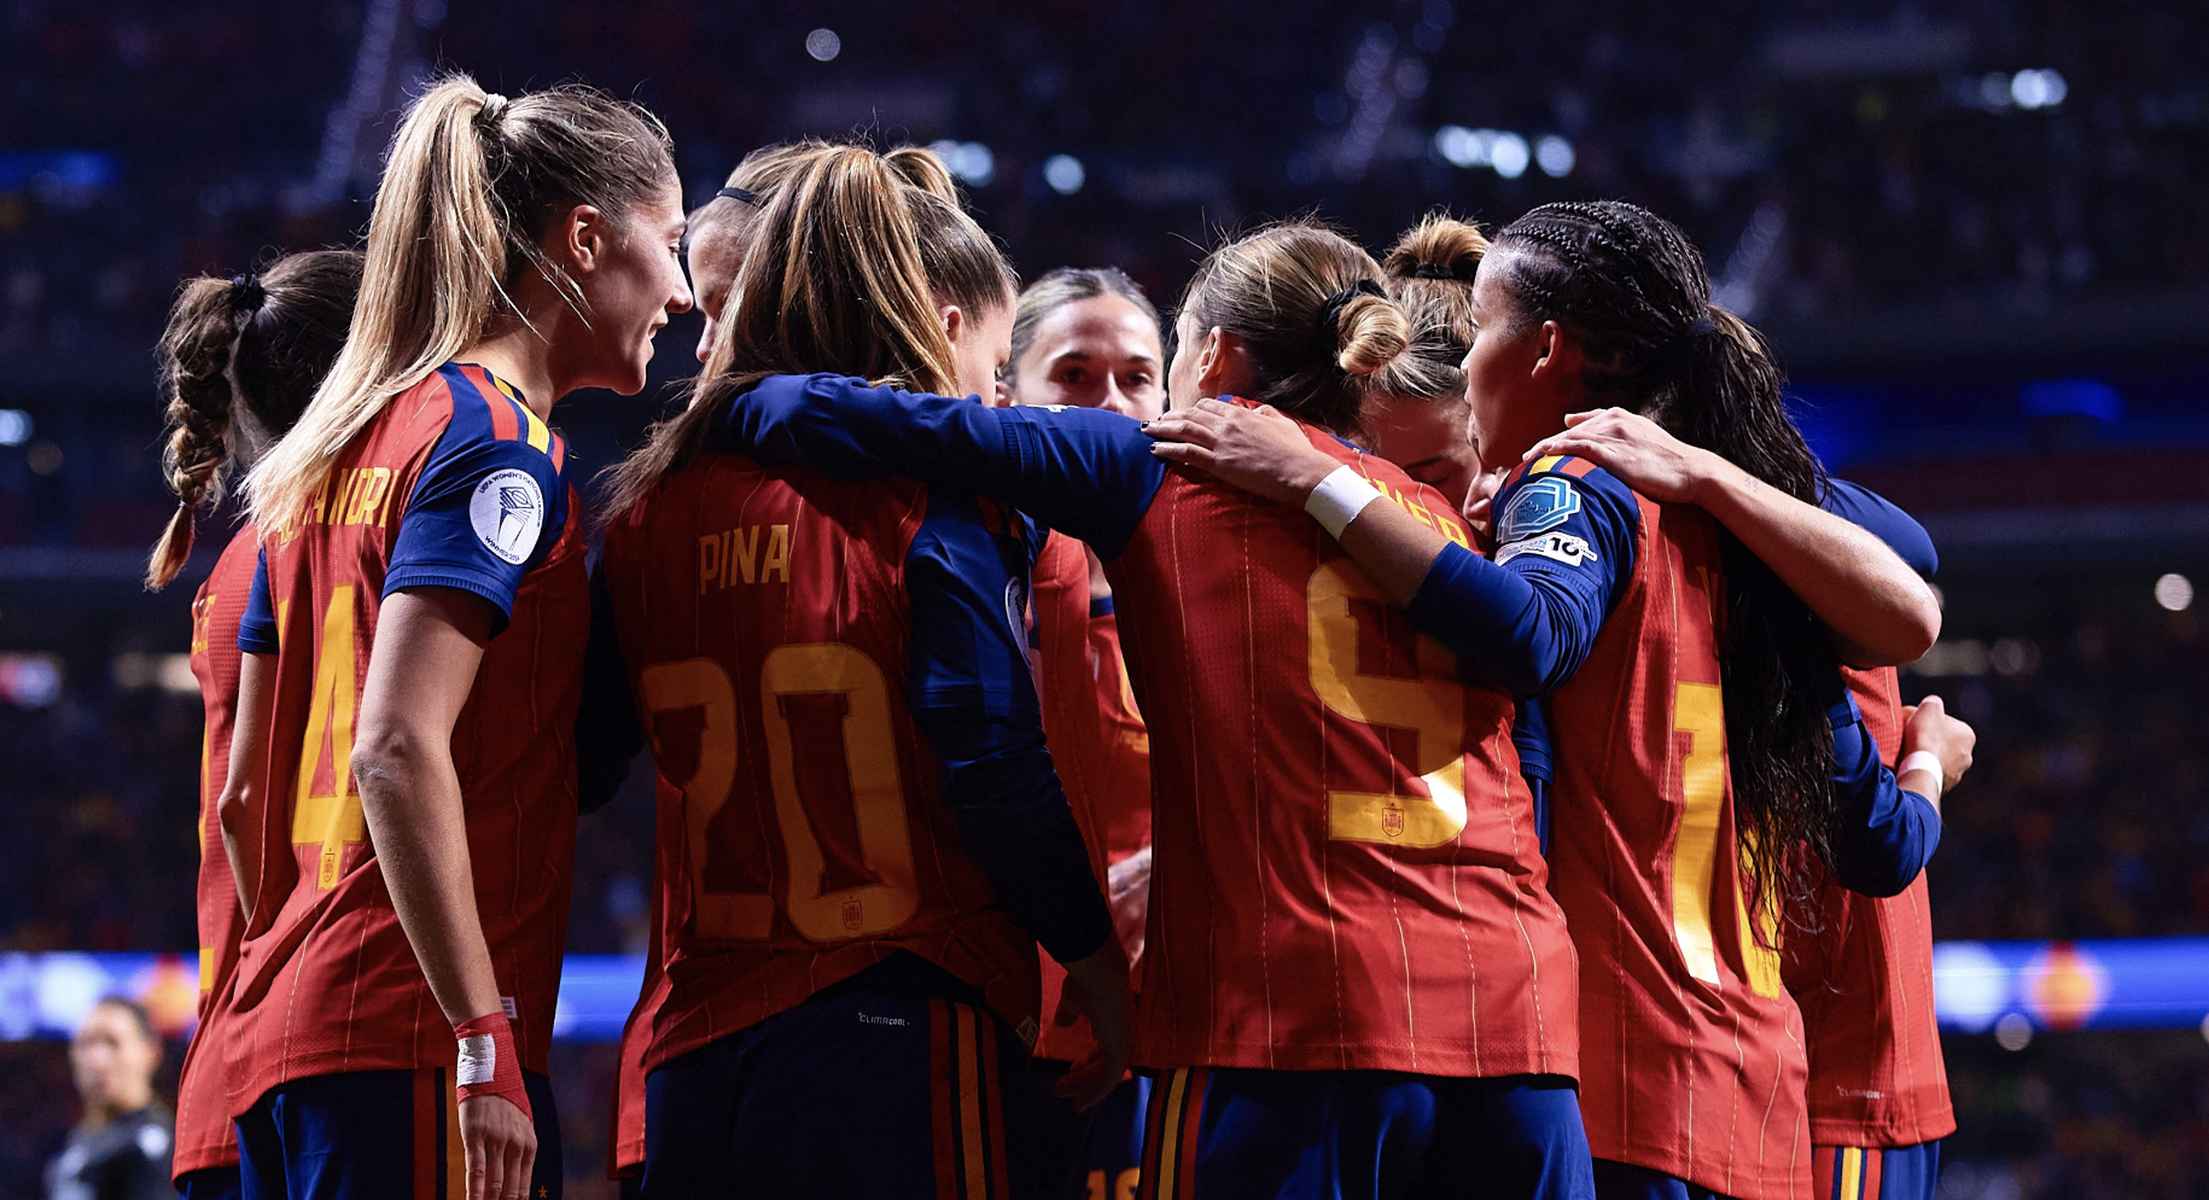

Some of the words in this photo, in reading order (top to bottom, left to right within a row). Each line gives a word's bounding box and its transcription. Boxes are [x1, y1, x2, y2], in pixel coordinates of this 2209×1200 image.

[700, 523, 790, 595] PINA
[278, 584, 366, 890] 4
[640, 642, 921, 943] 20
